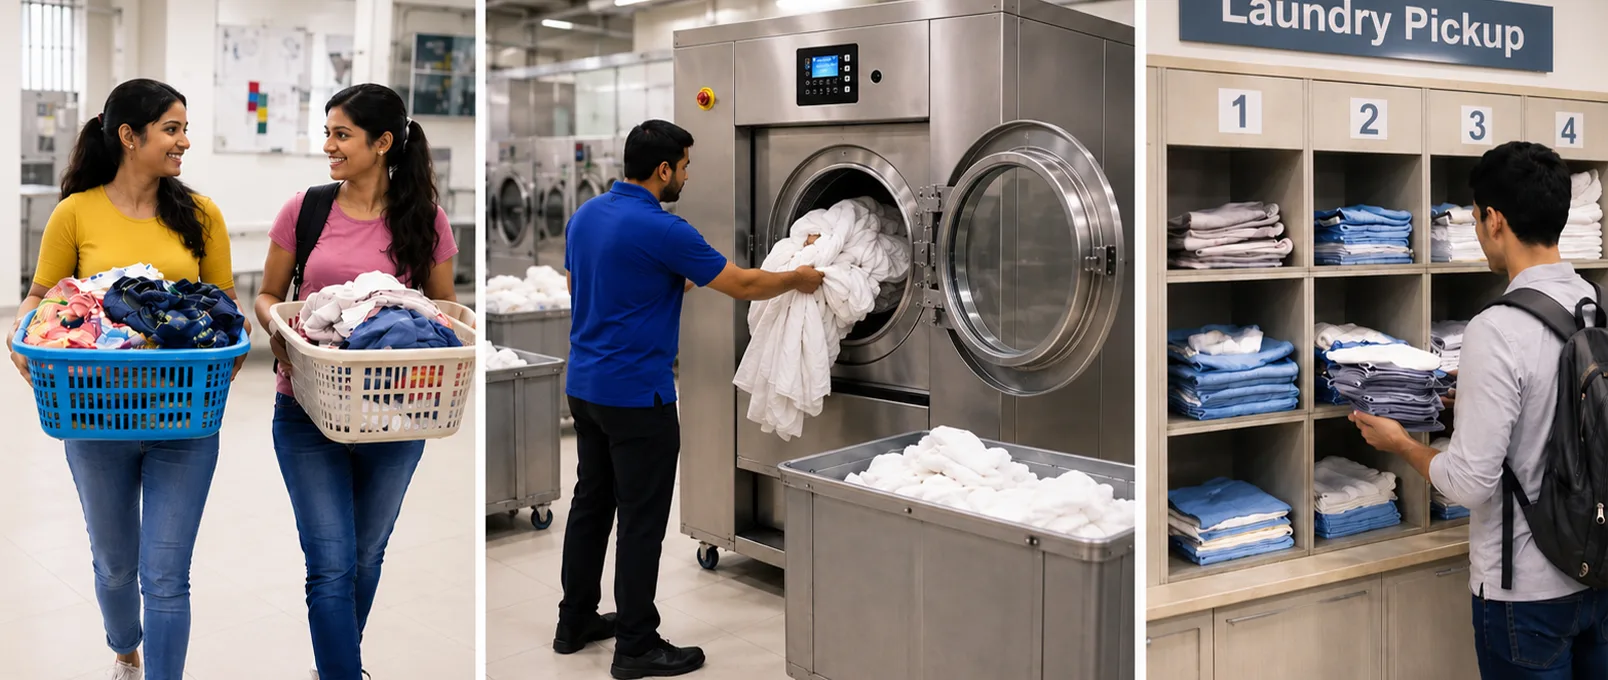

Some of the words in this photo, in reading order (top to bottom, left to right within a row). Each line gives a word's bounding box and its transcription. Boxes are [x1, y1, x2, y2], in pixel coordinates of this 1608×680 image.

[1222, 0, 1392, 47] Laundry
[1405, 5, 1525, 58] Pickup
[1232, 94, 1247, 129] 1
[1359, 103, 1379, 135] 2
[1469, 110, 1486, 141] 3
[1561, 117, 1577, 144] 4
